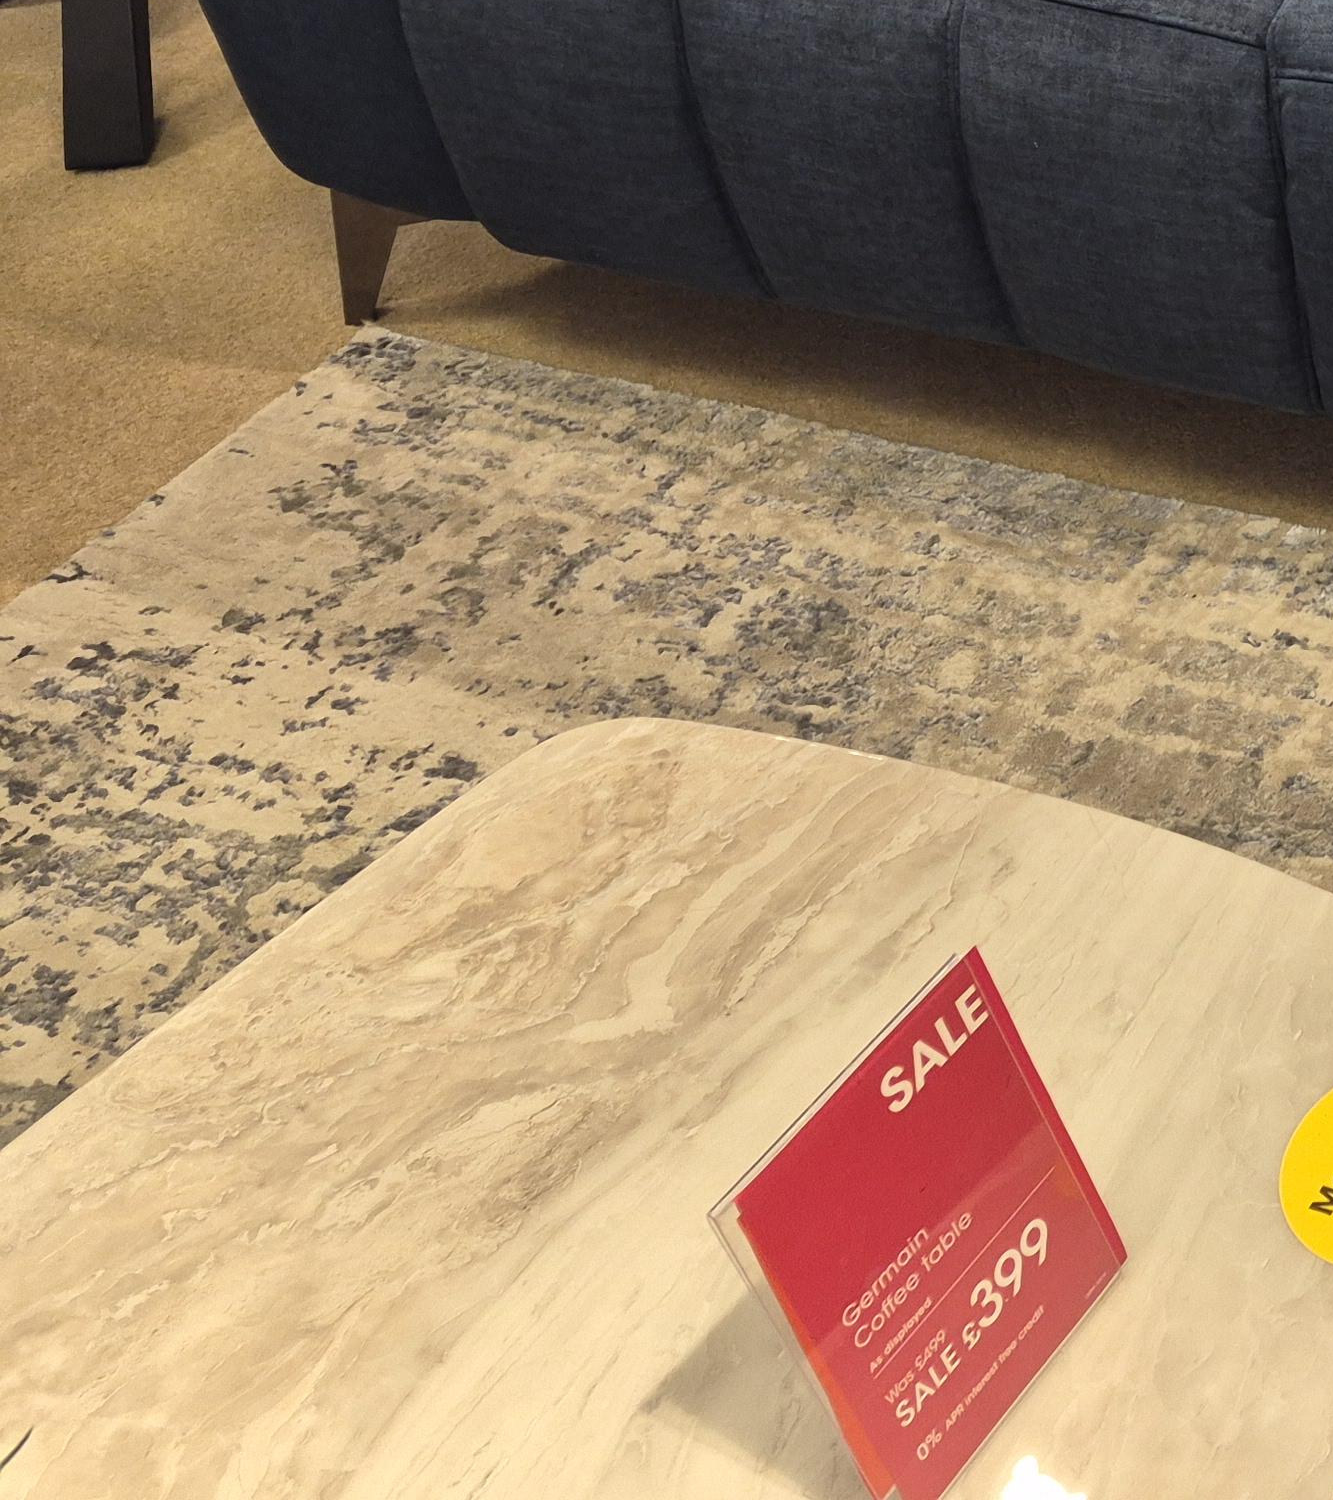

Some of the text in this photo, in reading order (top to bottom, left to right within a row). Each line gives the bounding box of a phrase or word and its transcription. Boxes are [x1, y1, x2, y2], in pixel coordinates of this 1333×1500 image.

[879, 983, 991, 1113] SALE
[842, 1227, 930, 1327] Germain
[854, 1211, 973, 1348] Coffee table
[869, 1296, 933, 1374] As displayed
[895, 1217, 1050, 1428] SALE £399
[884, 1328, 946, 1404] Was £499
[916, 1304, 1045, 1461] 0% APR interest free credit
